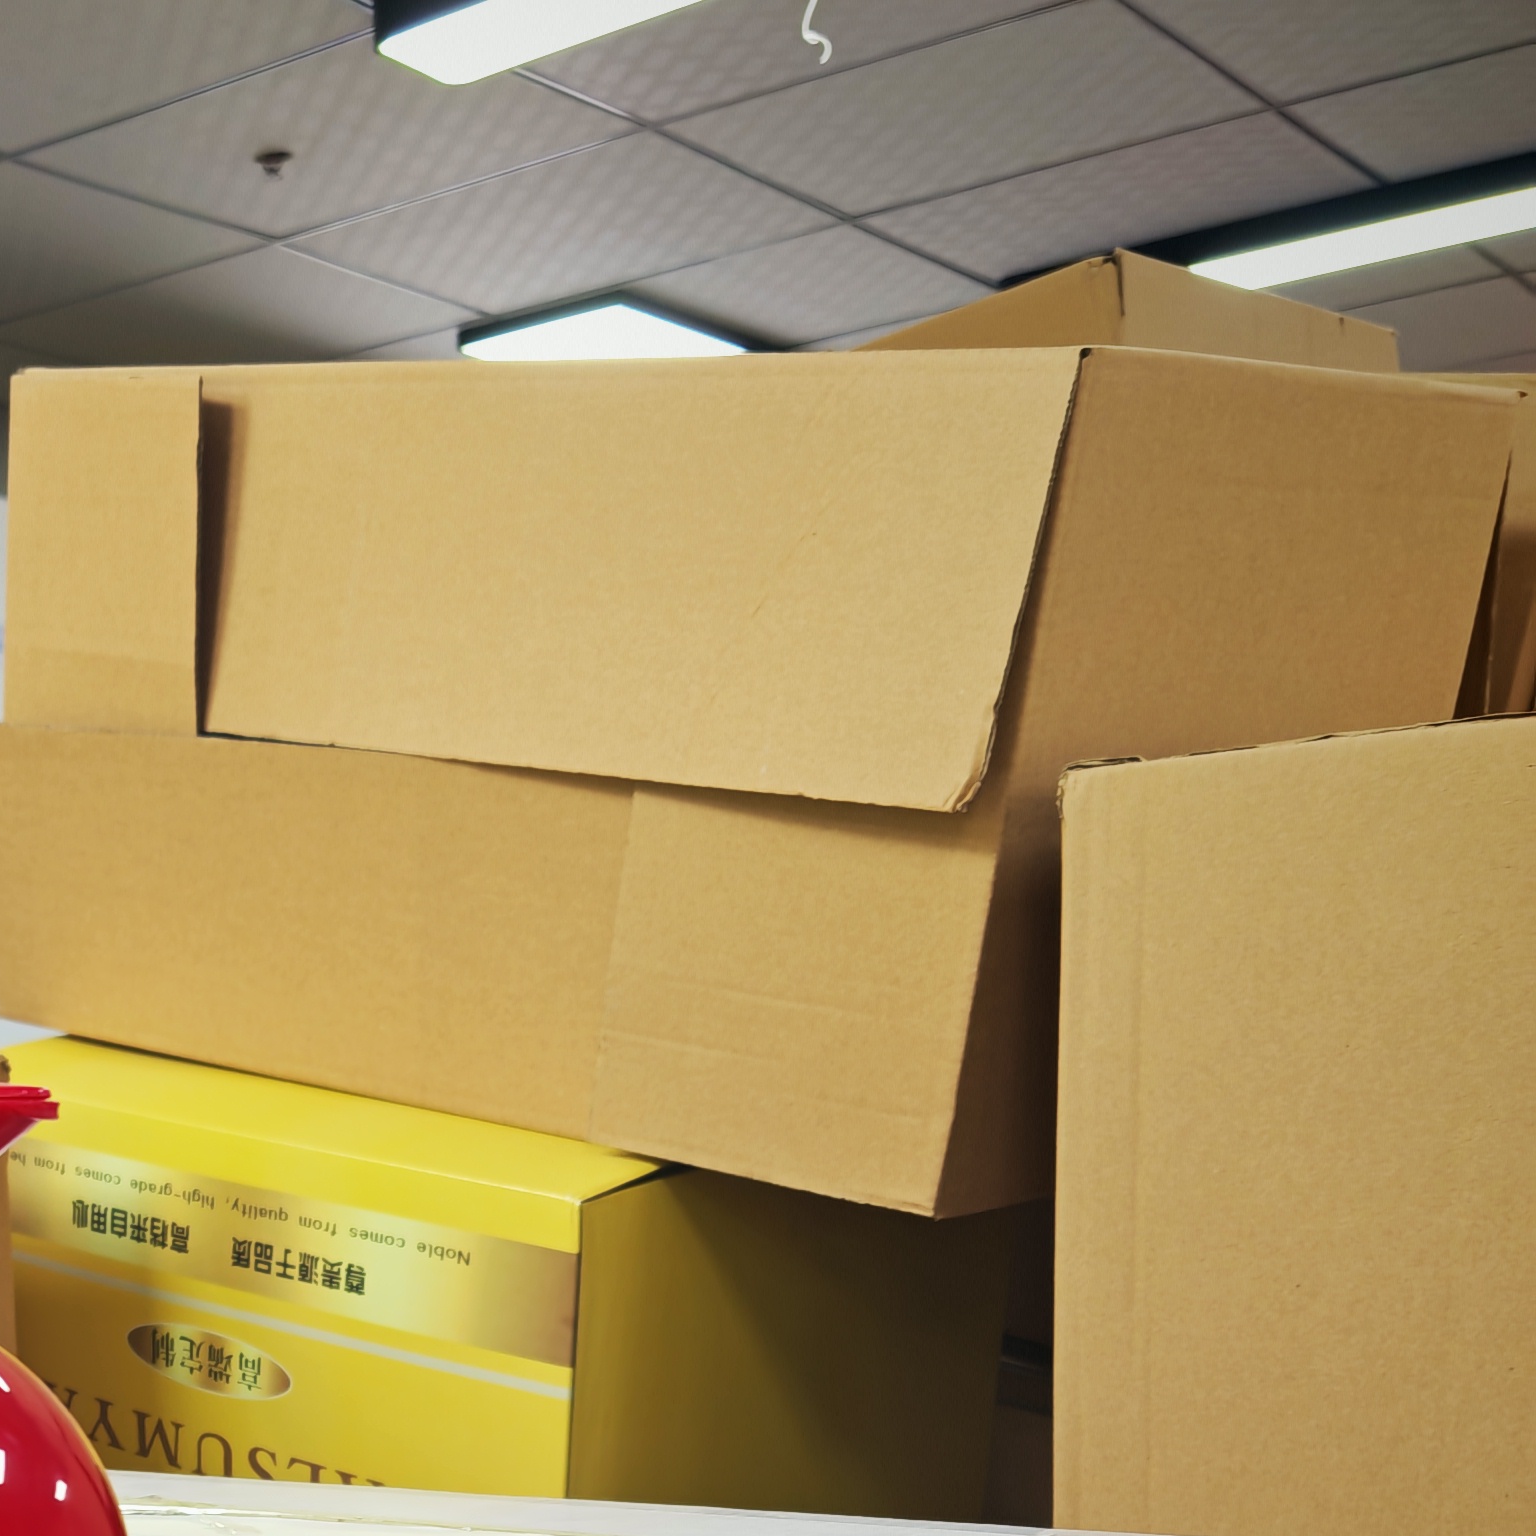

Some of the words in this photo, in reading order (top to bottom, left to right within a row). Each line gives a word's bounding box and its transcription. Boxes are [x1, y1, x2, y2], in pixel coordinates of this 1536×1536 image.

[34, 1155, 66, 1176] from
[75, 1165, 121, 1186] comes
[129, 1178, 215, 1210] high-grade
[225, 1196, 289, 1223] quality,
[72, 1199, 190, 1255] 高档来自用心
[298, 1215, 337, 1237] from
[349, 1227, 406, 1249] comes
[231, 1236, 367, 1296] 尊贵源于品质
[416, 1241, 471, 1266] Noble
[151, 1326, 263, 1392] 高端定制
